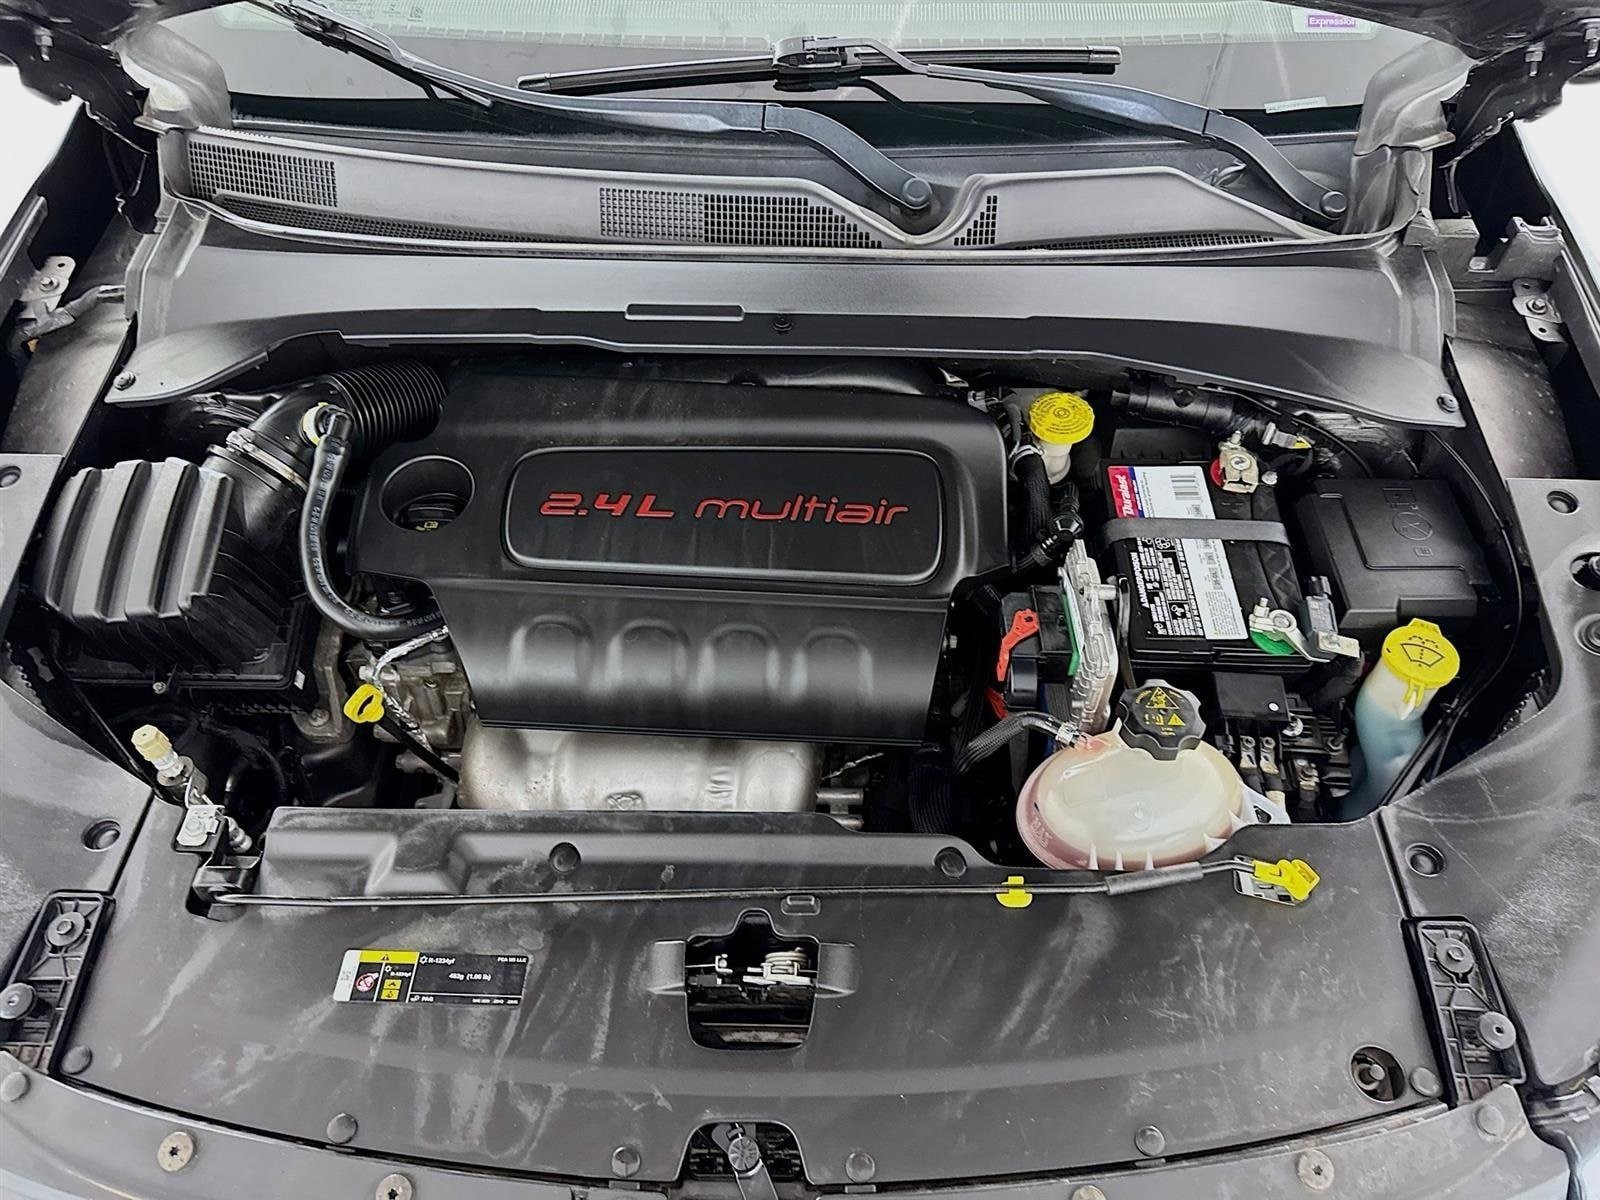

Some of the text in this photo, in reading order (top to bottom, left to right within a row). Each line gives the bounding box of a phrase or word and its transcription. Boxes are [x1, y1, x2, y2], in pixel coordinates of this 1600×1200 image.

[539, 492, 909, 525] 2.4L multiair
[1114, 474, 1135, 517] Duralast
